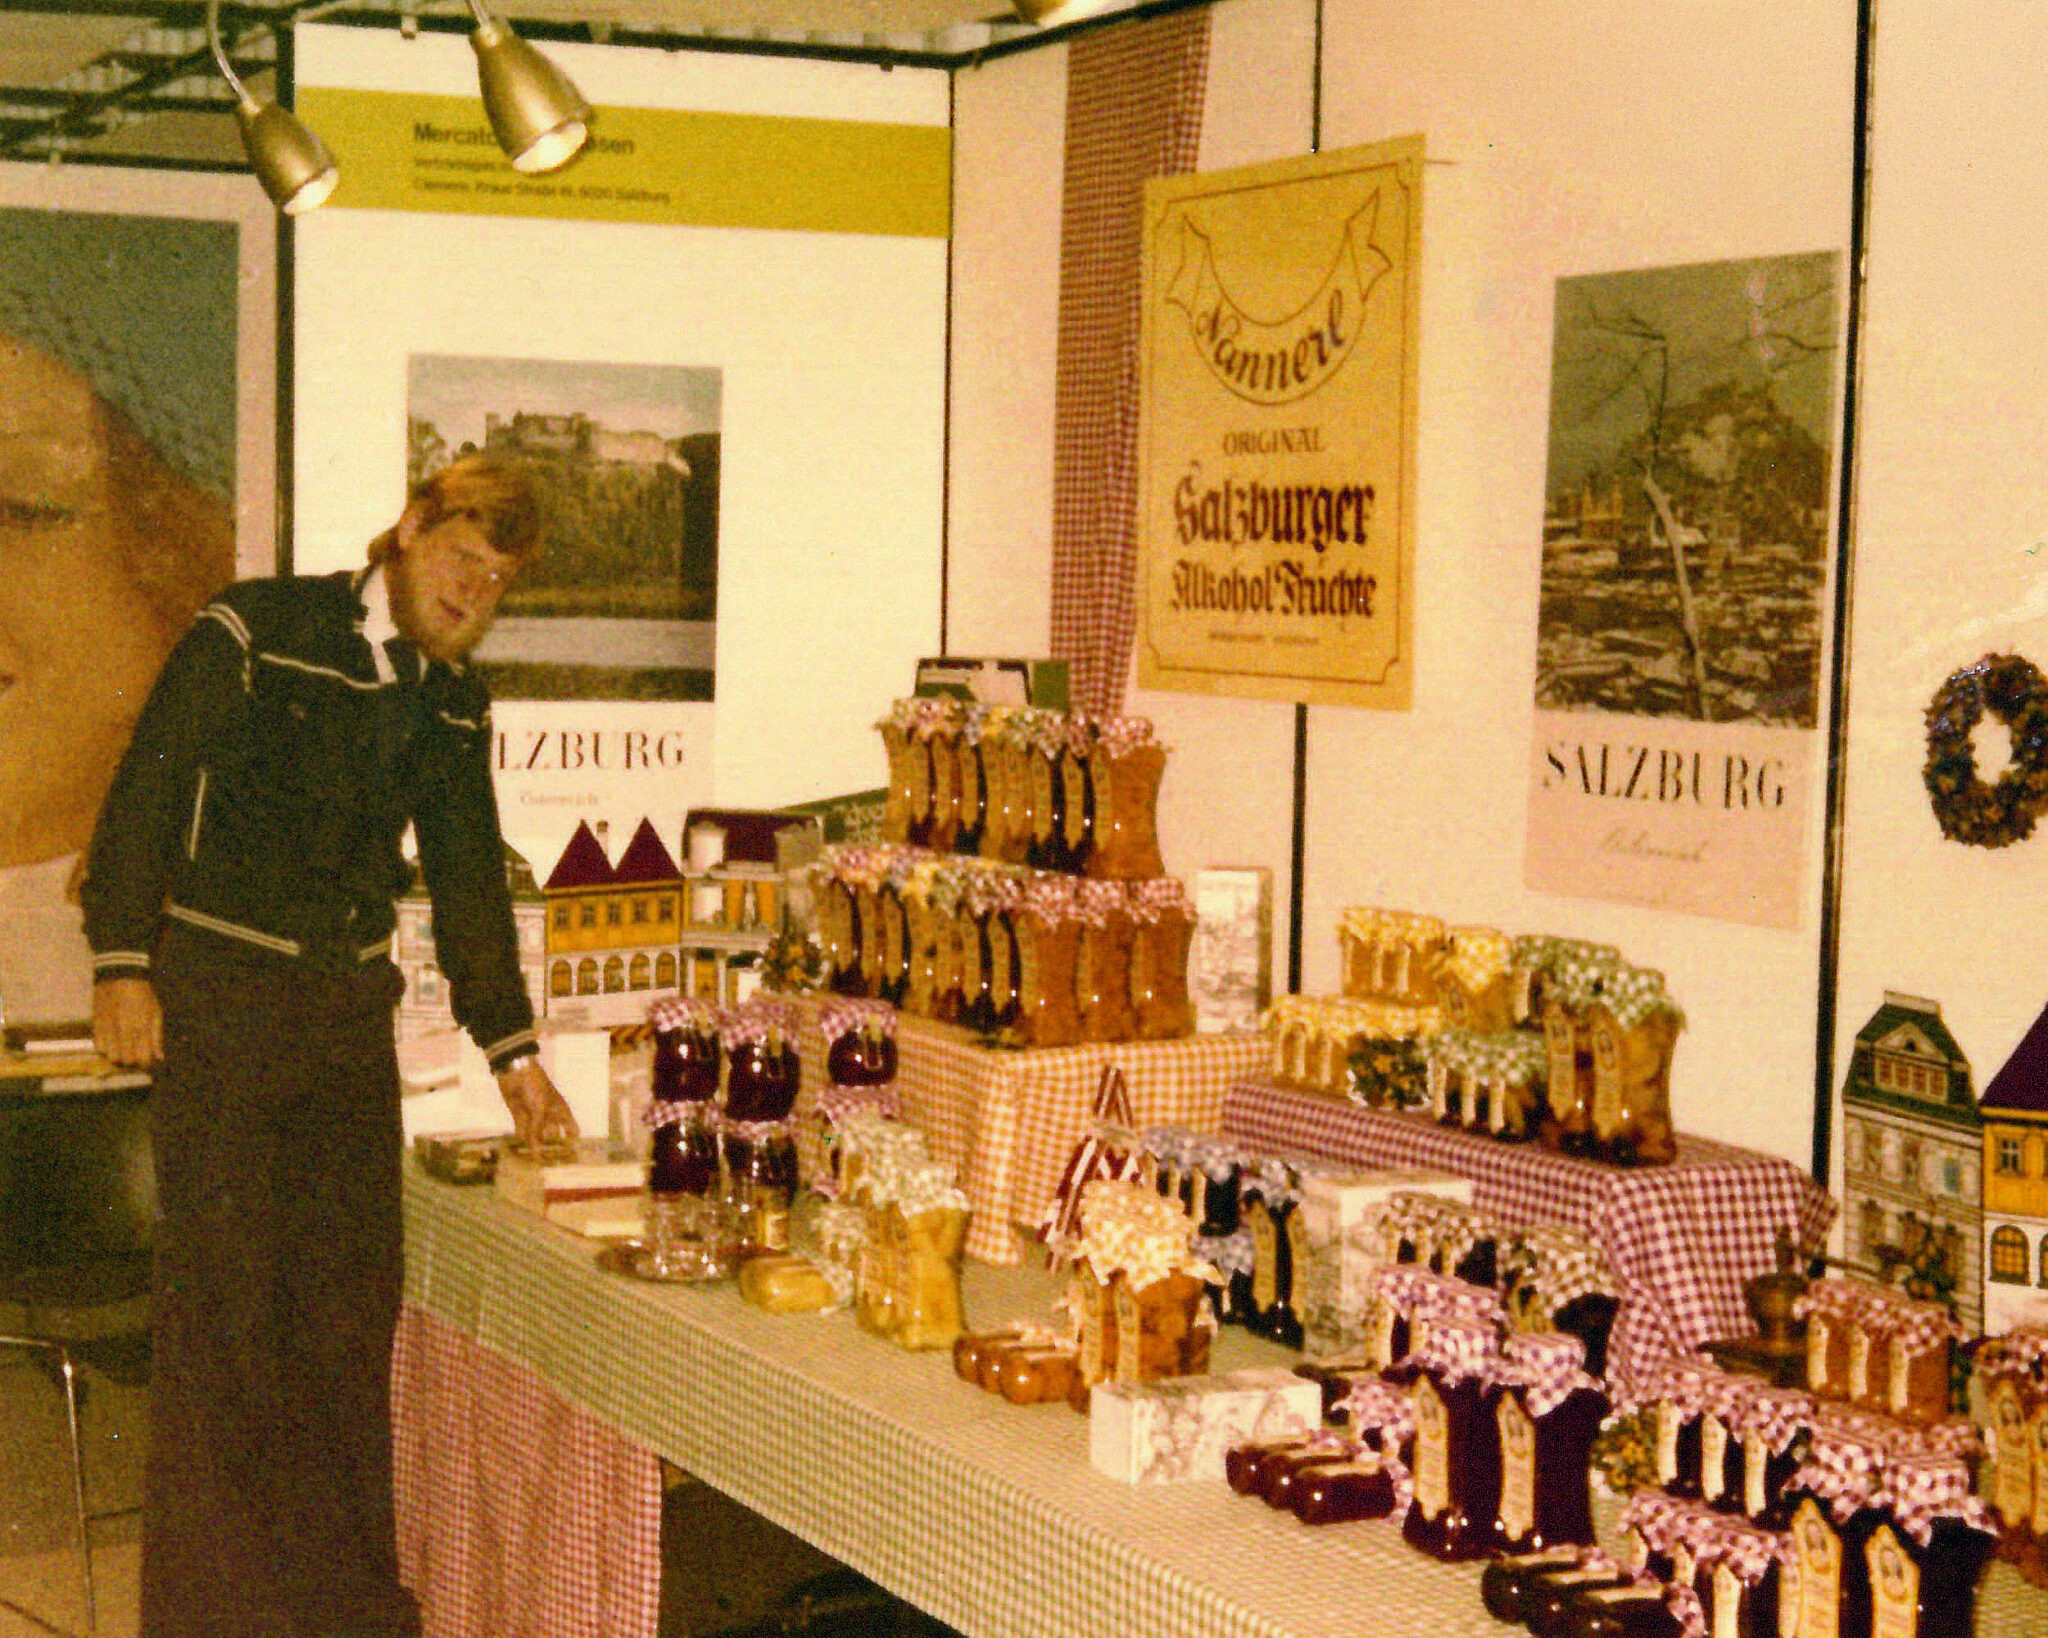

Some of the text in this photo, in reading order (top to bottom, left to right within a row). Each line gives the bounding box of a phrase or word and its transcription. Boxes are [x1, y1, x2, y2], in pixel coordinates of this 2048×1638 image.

[1222, 427, 1326, 456] ORIGINAL
[1174, 459, 1376, 556] Salzburger
[498, 731, 684, 770] LZBURG
[1543, 740, 1788, 810] SALZBURG
